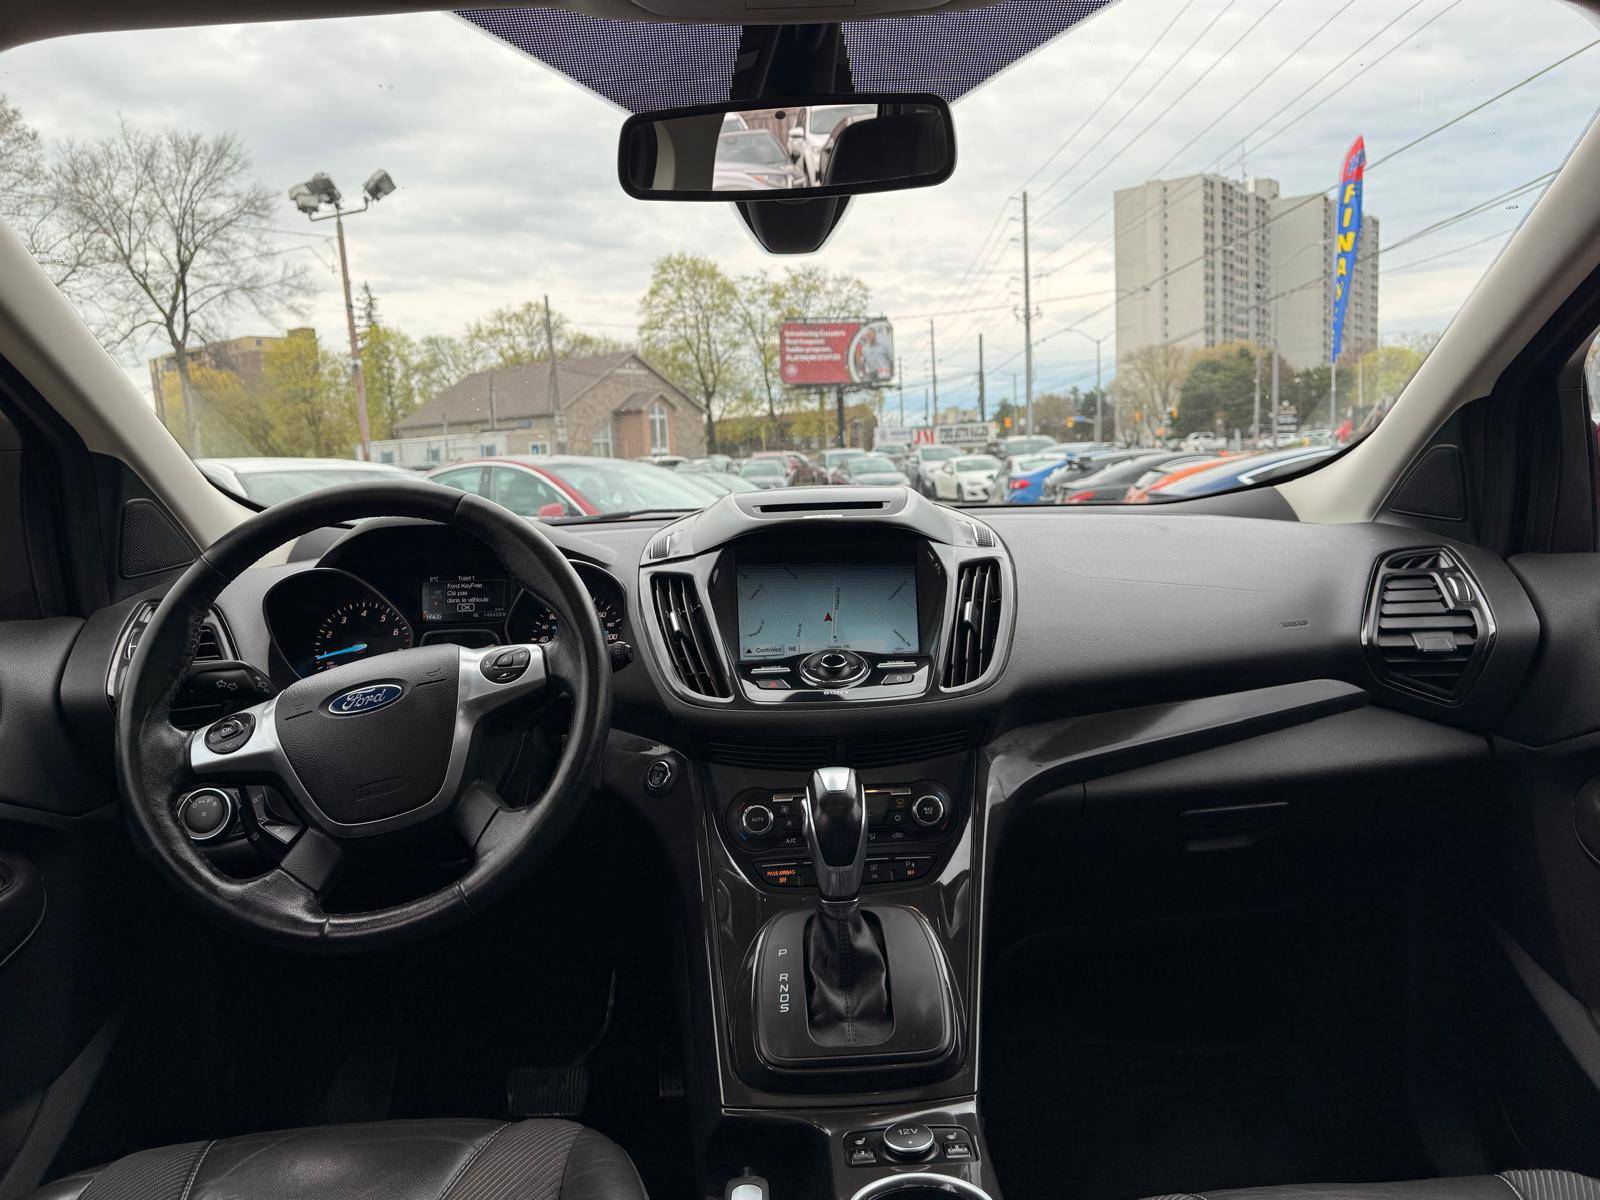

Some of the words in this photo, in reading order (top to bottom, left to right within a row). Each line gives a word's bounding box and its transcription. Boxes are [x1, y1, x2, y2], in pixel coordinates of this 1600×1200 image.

[340, 616, 347, 624] 3
[342, 688, 386, 711] Ford
[778, 948, 788, 957] P
[897, 1127, 918, 1136] 12V
